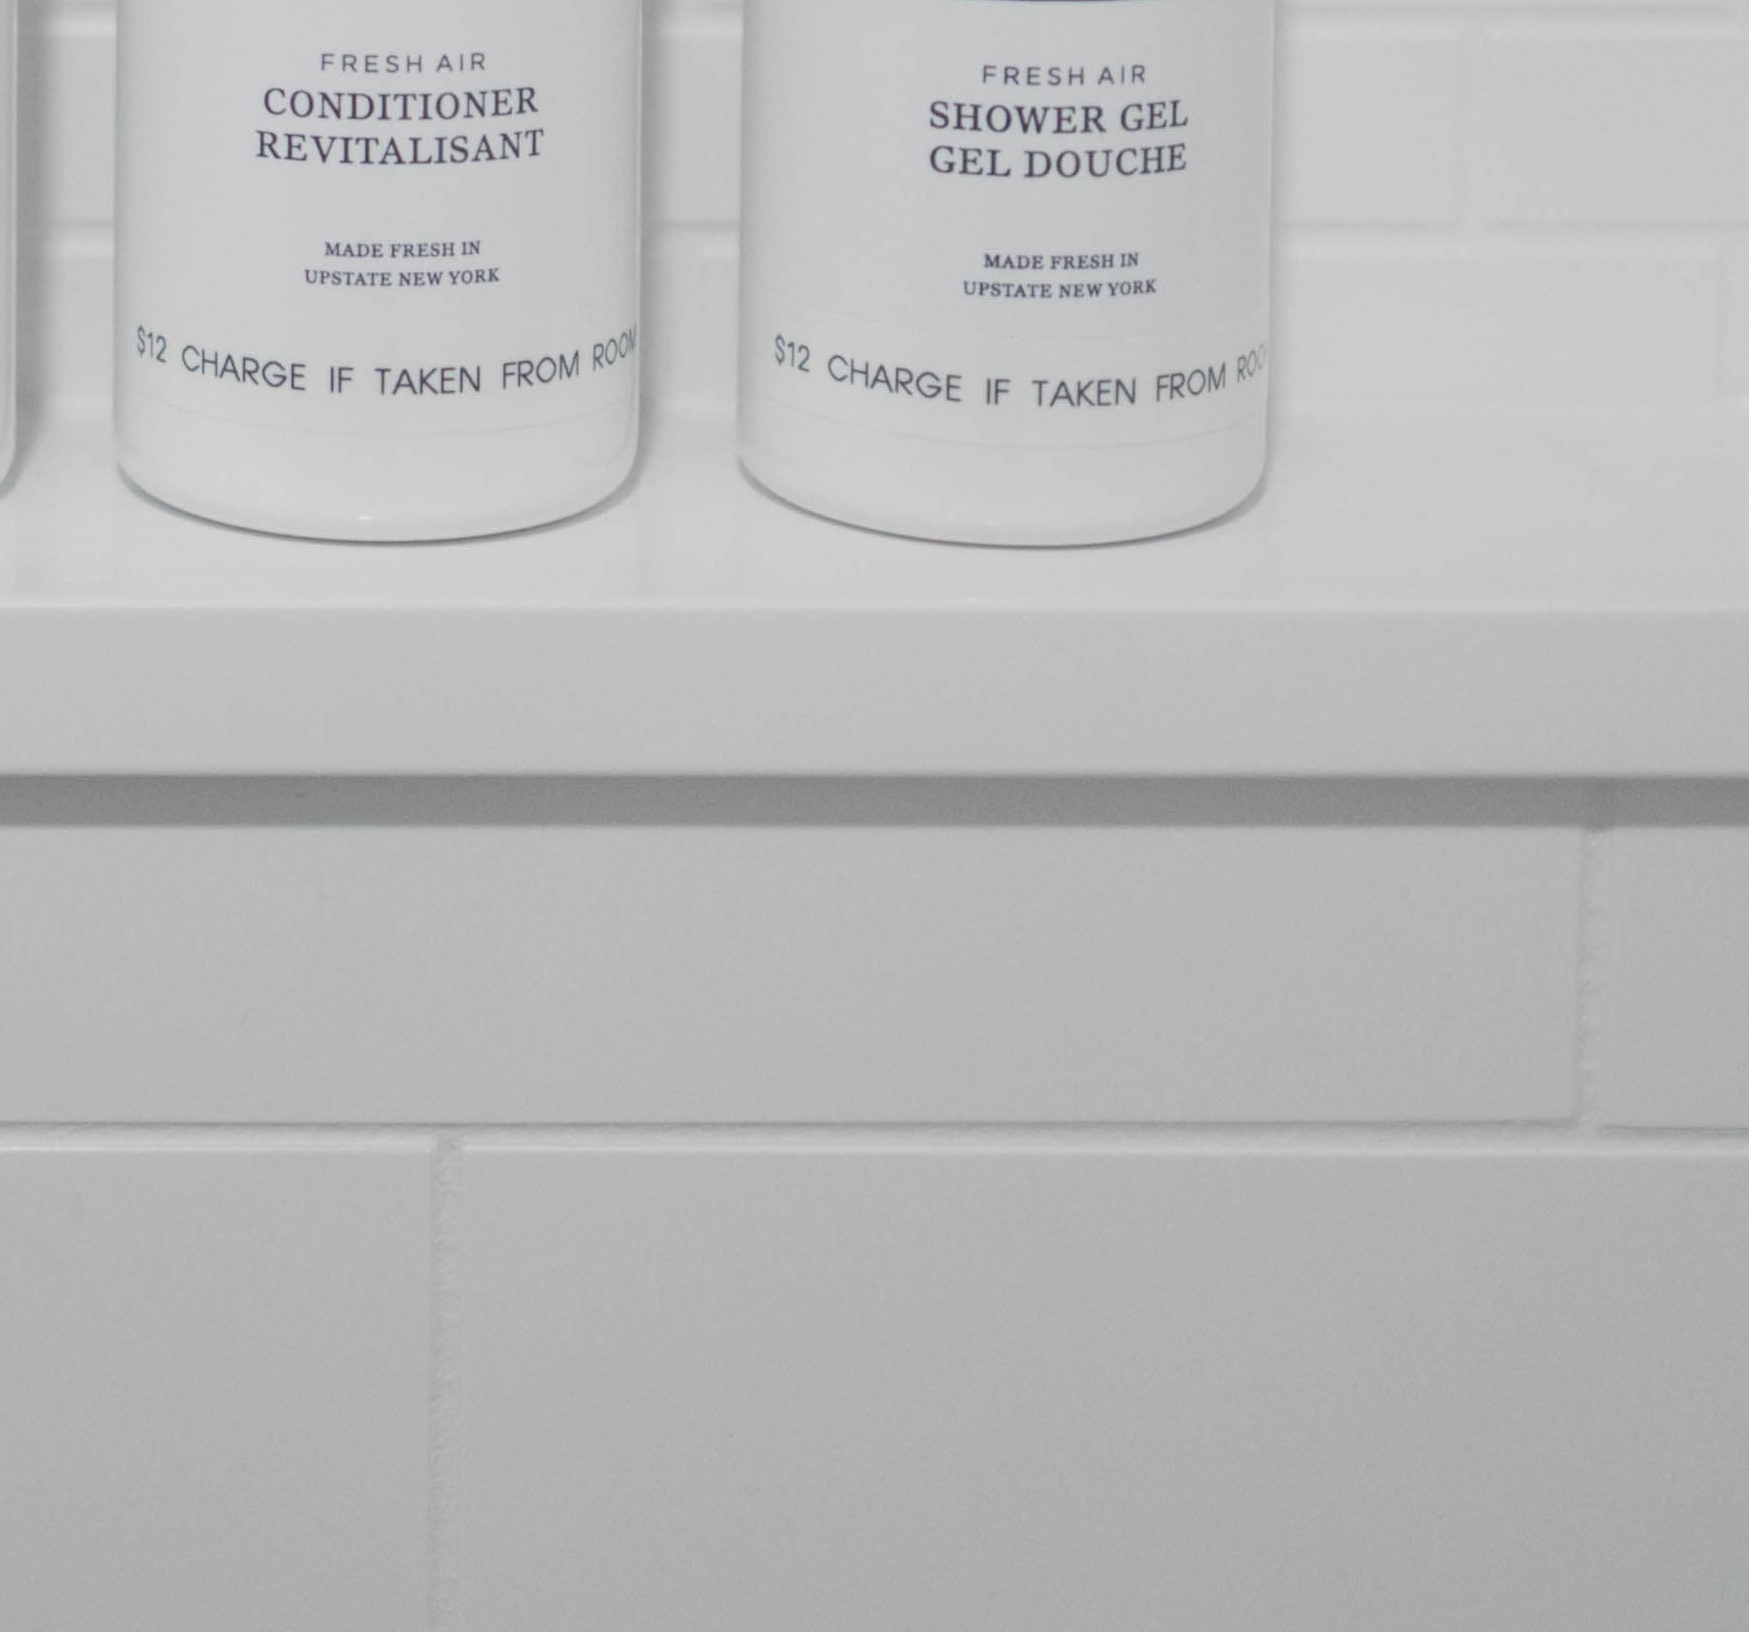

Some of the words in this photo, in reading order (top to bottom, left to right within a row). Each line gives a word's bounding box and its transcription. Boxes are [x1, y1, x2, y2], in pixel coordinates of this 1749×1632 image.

[320, 52, 423, 74] FRESH
[435, 51, 486, 73] AIR
[981, 64, 1085, 87] FRESH
[1096, 63, 1146, 86] AIR
[263, 86, 540, 122] CONDITIONER
[928, 99, 1107, 135] SHOWER
[1119, 98, 1189, 133] GEL
[255, 127, 545, 166] REVITALISANT
[928, 144, 1012, 178] GEL
[1022, 142, 1188, 180] DOUCHE
[323, 241, 385, 259] MADE
[389, 241, 456, 259] FRESH
[460, 239, 482, 256] IN
[983, 252, 1045, 271] MADE
[1049, 253, 1116, 271] FRESH
[1119, 251, 1140, 269] IN
[303, 268, 393, 288] UPSTATE
[397, 270, 444, 288] NEW
[447, 266, 500, 286] YORK
[962, 279, 1053, 299] UPSTATE
[1057, 282, 1104, 299] NEW
[1106, 278, 1157, 298] YORK
[136, 324, 167, 364] $12
[181, 344, 307, 392] CHARGE
[329, 365, 355, 395] IF
[373, 364, 482, 396] TAKEN
[501, 349, 580, 391] FROM
[774, 333, 811, 374] $12
[826, 353, 963, 403] CHARGE
[985, 377, 1012, 406] IF
[1031, 377, 1137, 408] TAKEN
[1155, 361, 1227, 403] FROM
[1236, 342, 1267, 384] ROO
